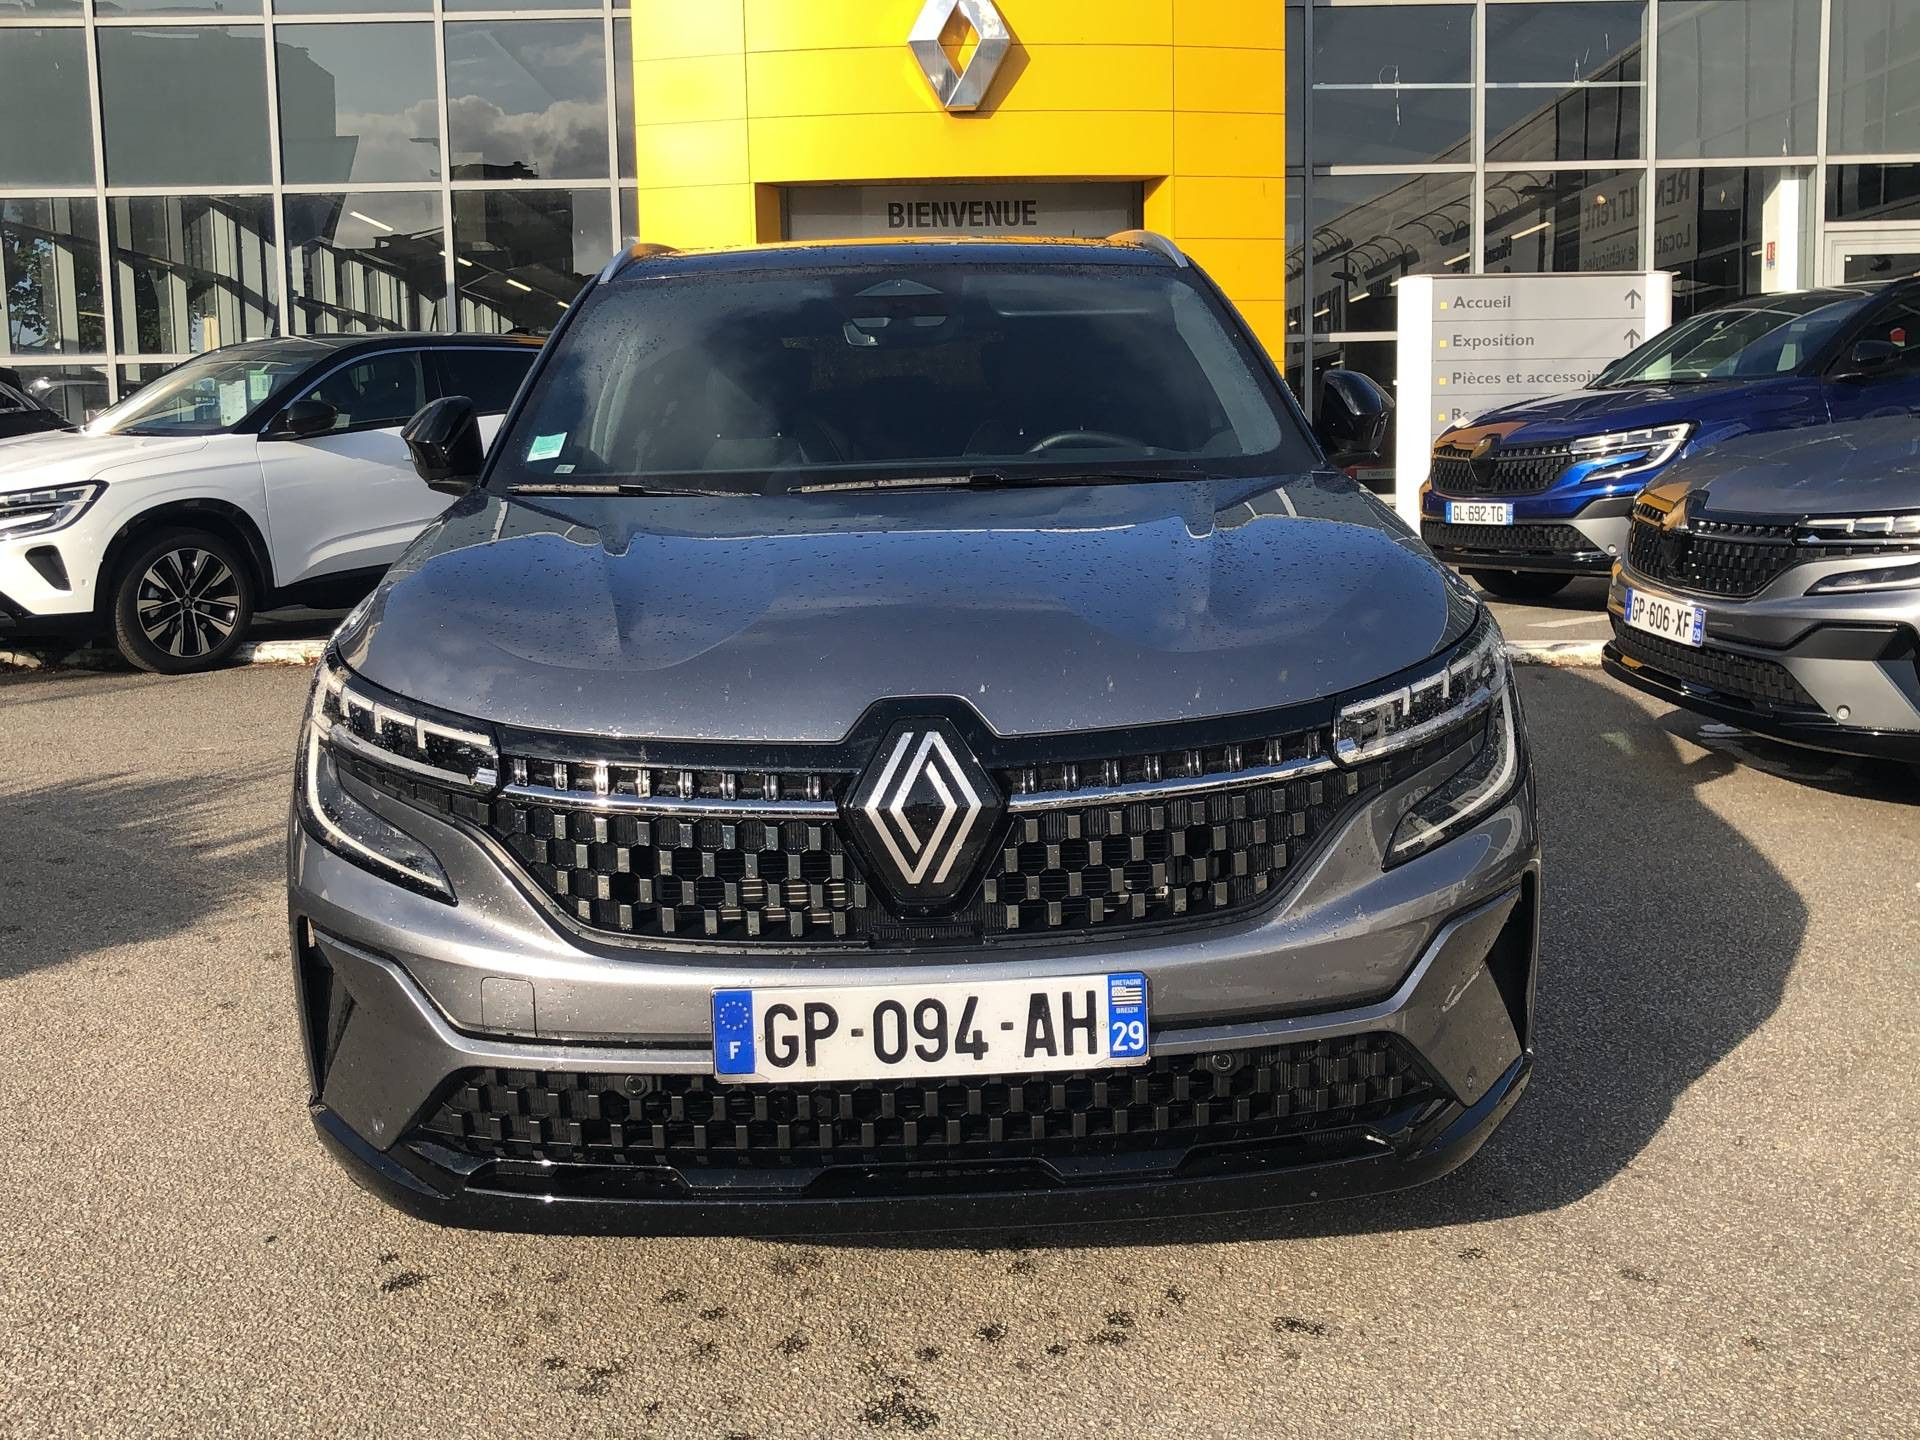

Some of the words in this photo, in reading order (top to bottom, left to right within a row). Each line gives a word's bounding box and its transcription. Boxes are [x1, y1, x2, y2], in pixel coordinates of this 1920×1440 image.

[888, 200, 1037, 228] BIENVENUE
[1453, 296, 1511, 309] Accueil
[1453, 333, 1535, 350] Exposition
[1453, 371, 1501, 385] Pièces
[1506, 373, 1522, 384] et
[1112, 1020, 1144, 1051] 29
[729, 1041, 741, 1060] F
